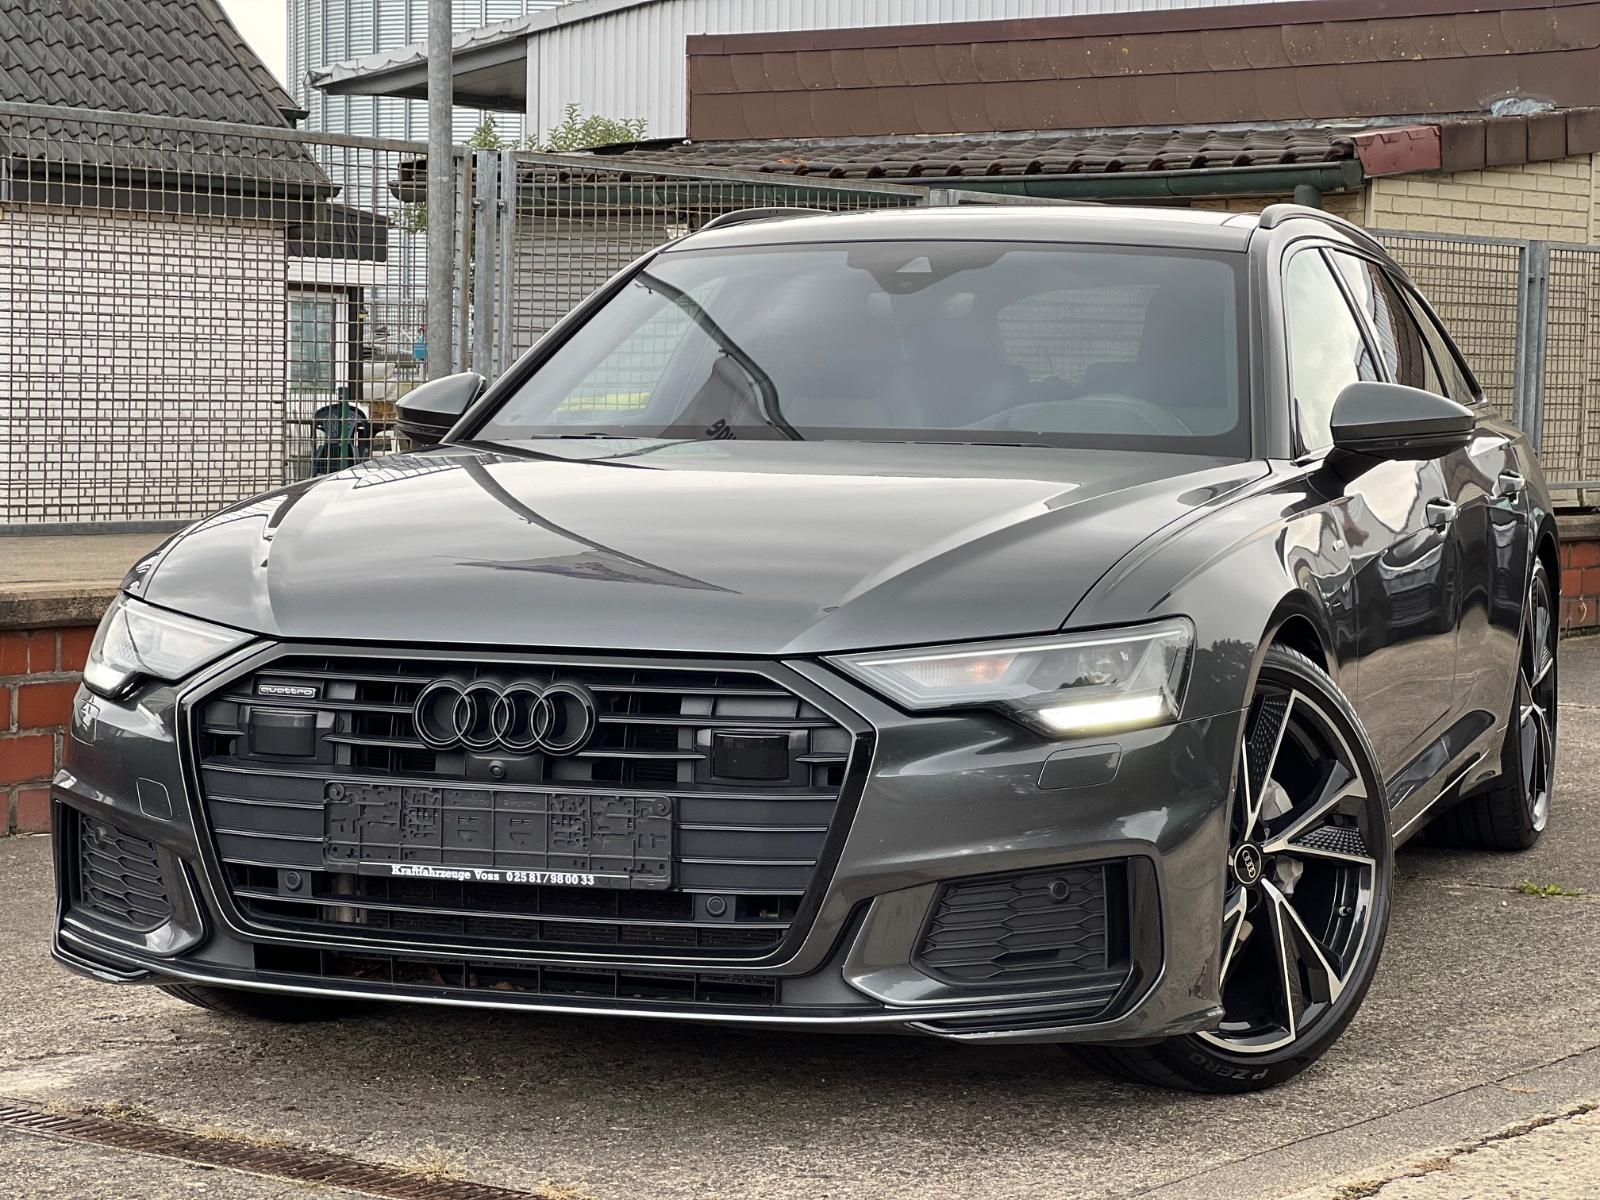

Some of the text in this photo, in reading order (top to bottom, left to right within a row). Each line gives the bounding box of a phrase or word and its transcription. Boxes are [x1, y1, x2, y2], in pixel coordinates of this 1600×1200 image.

[260, 686, 313, 696] quattro
[391, 864, 471, 881] Kraftfahrzeuge
[474, 869, 500, 881] Voss
